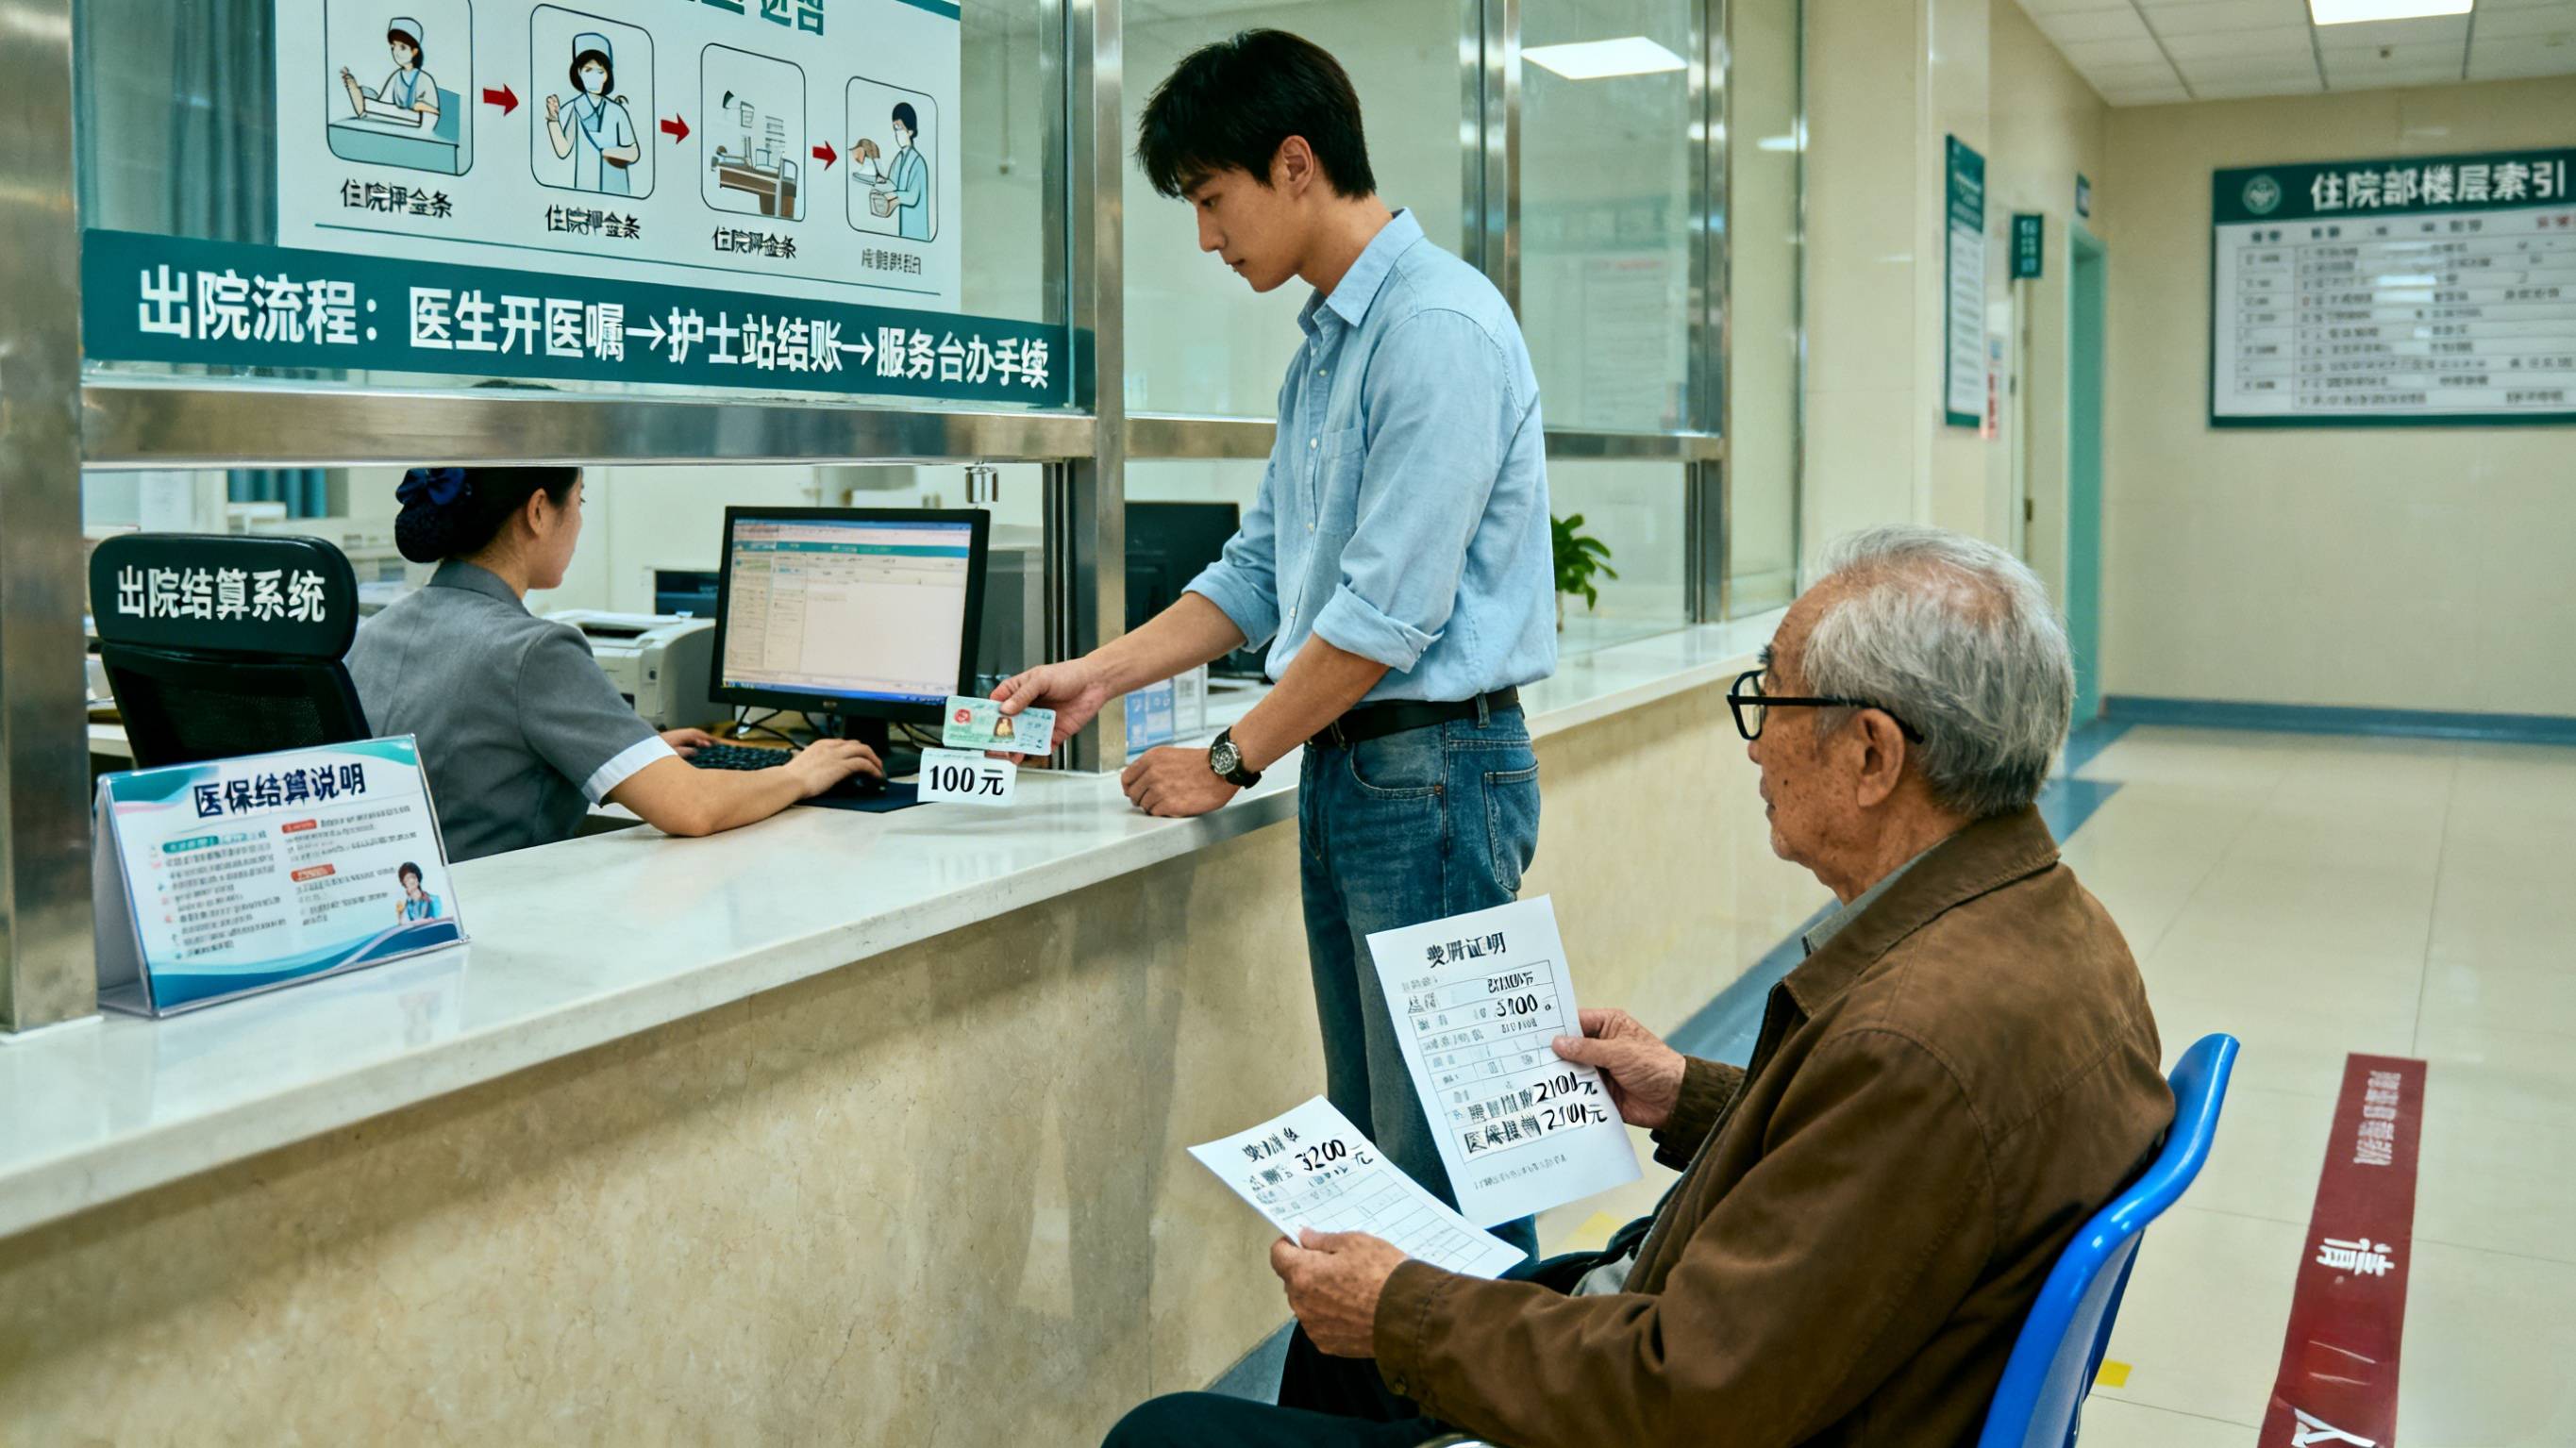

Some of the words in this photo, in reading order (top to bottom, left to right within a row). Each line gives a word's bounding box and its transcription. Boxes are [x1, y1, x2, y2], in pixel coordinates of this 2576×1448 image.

[2310, 159, 2567, 212] 住院部楼层索引
[117, 564, 326, 623] 出院结算系统
[193, 762, 366, 819] 医保结算说明
